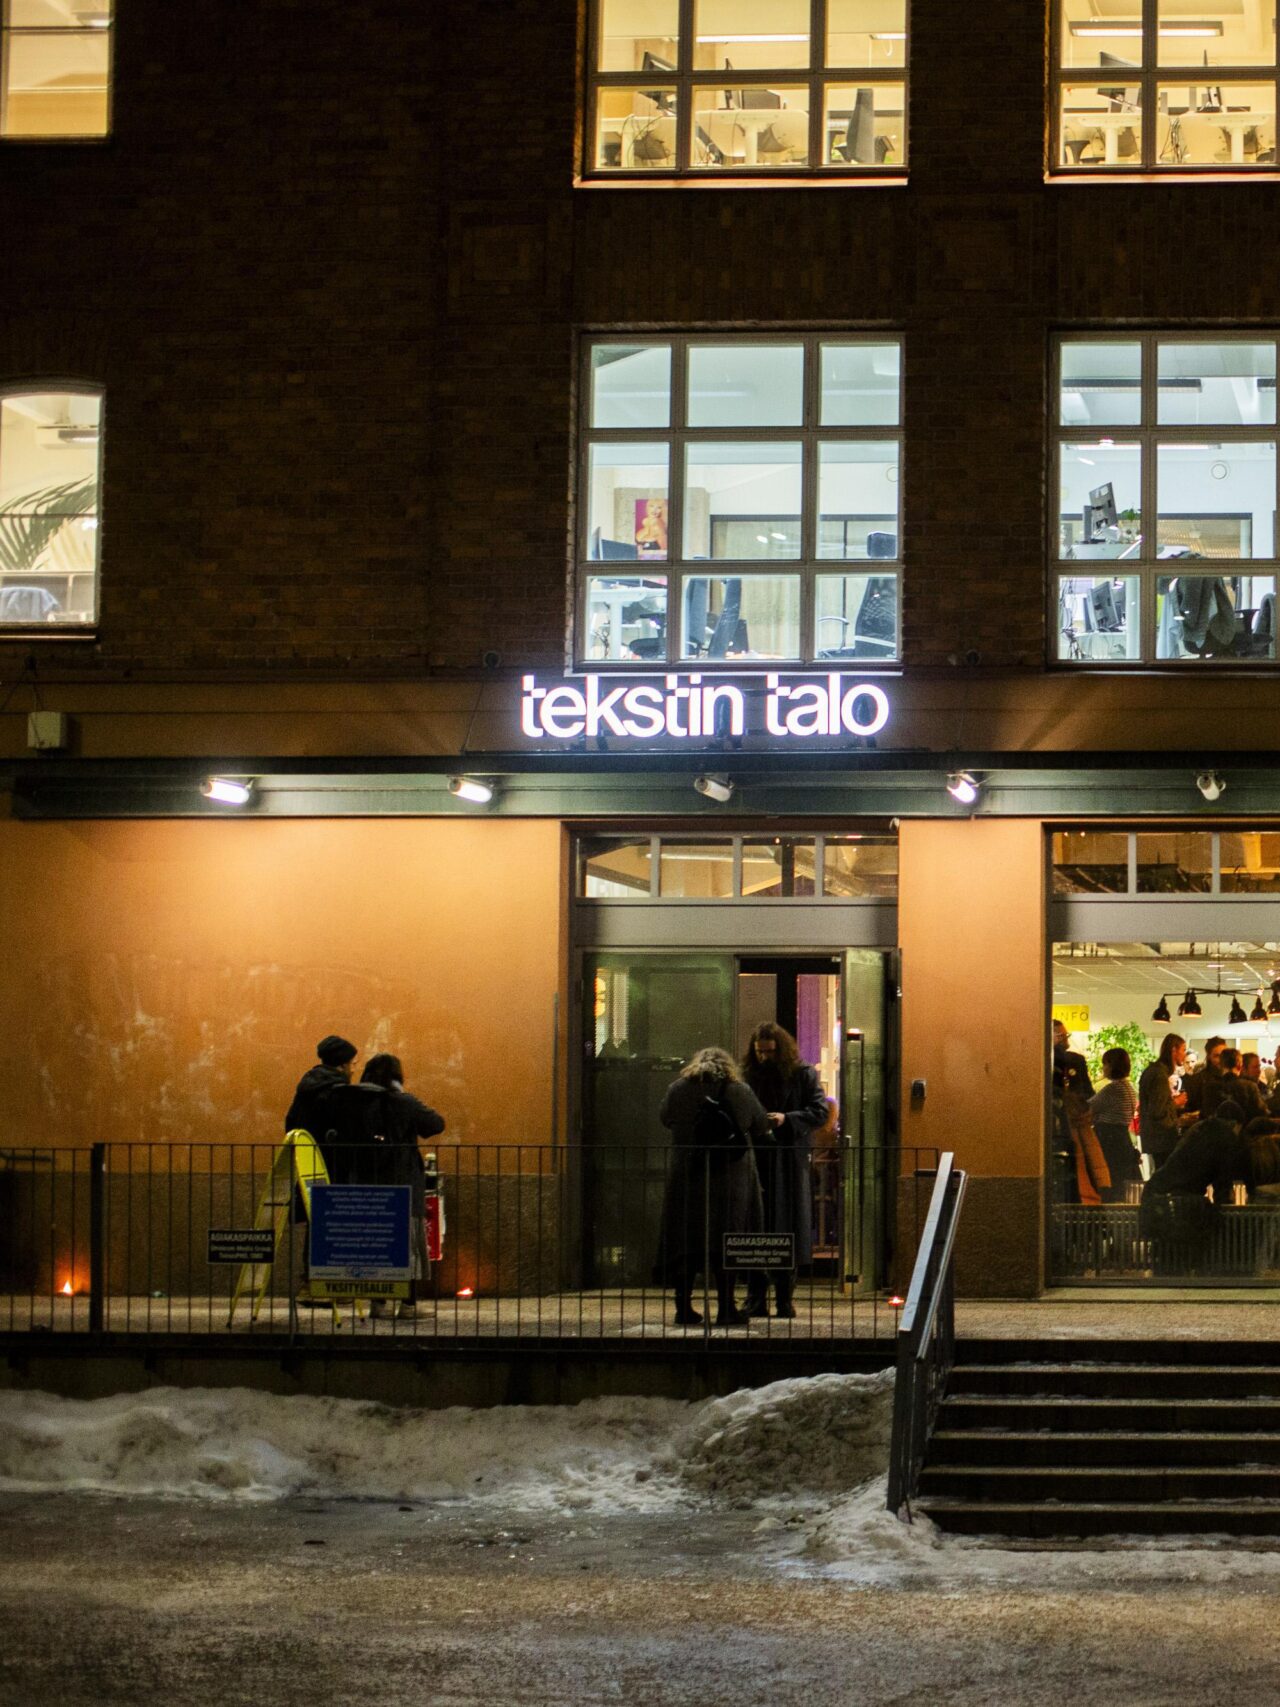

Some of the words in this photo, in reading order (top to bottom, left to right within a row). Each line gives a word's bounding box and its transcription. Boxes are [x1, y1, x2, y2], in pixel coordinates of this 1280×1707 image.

[522, 673, 744, 738] tekstin
[766, 673, 890, 737] talo
[1055, 1011, 1089, 1022] INFO
[727, 1237, 790, 1246] ASIAKASPAIKKA
